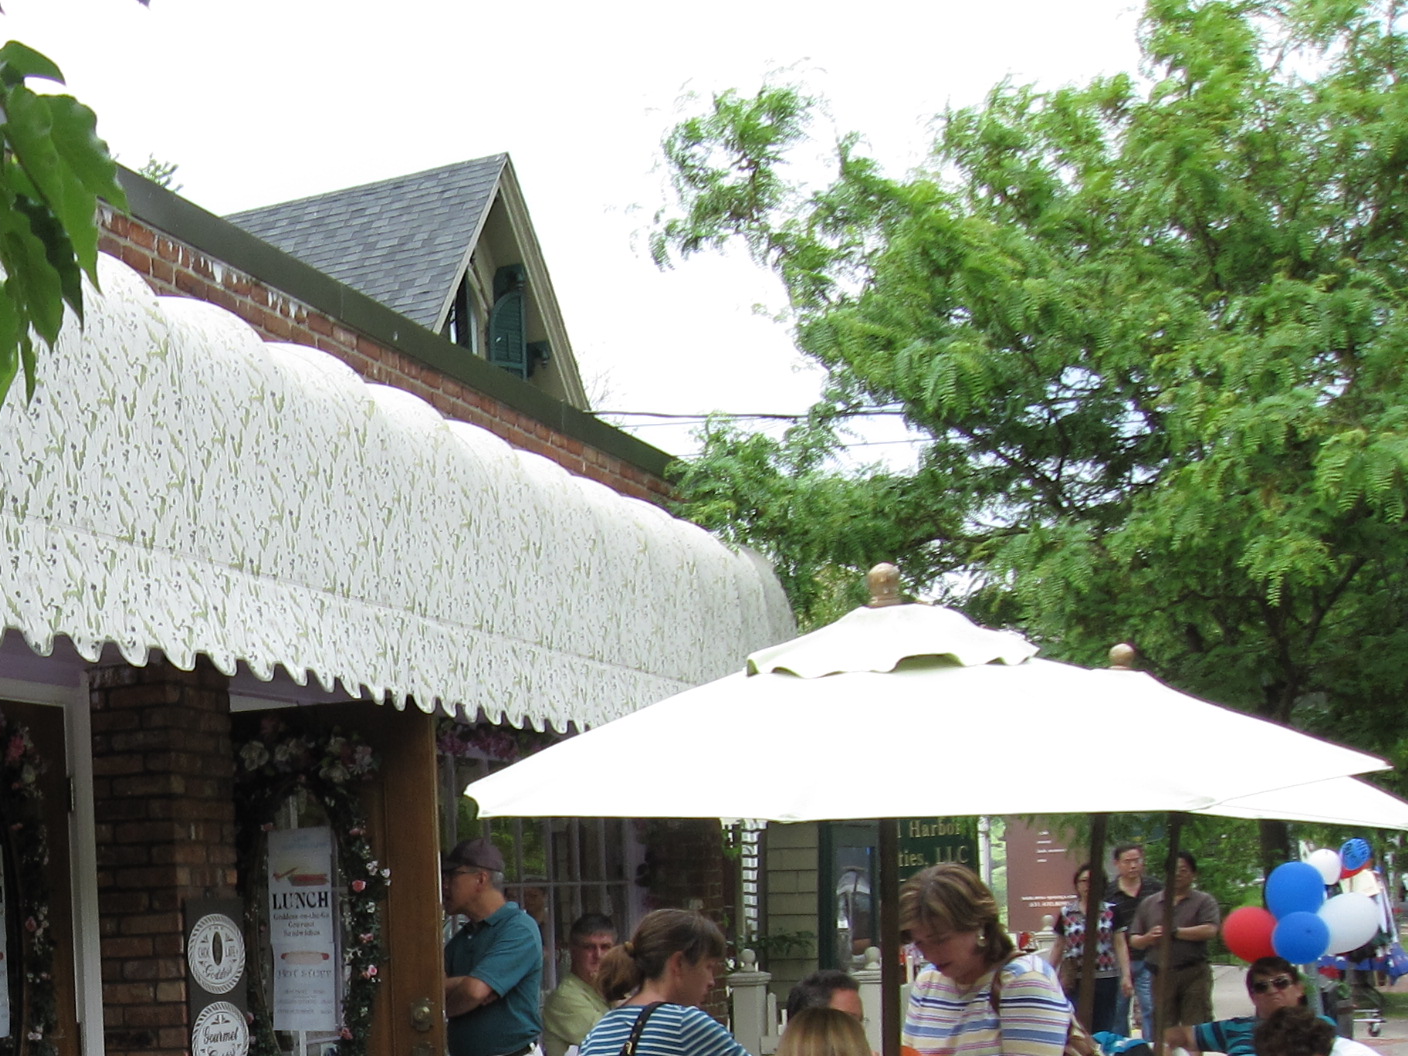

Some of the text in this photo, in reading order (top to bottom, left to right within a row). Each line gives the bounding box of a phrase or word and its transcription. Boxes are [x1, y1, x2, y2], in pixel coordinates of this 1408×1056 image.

[909, 818, 961, 838] Harbor
[935, 845, 969, 865] LLC
[272, 891, 329, 910] LUNCH
[203, 1026, 239, 1045] Gourmet
